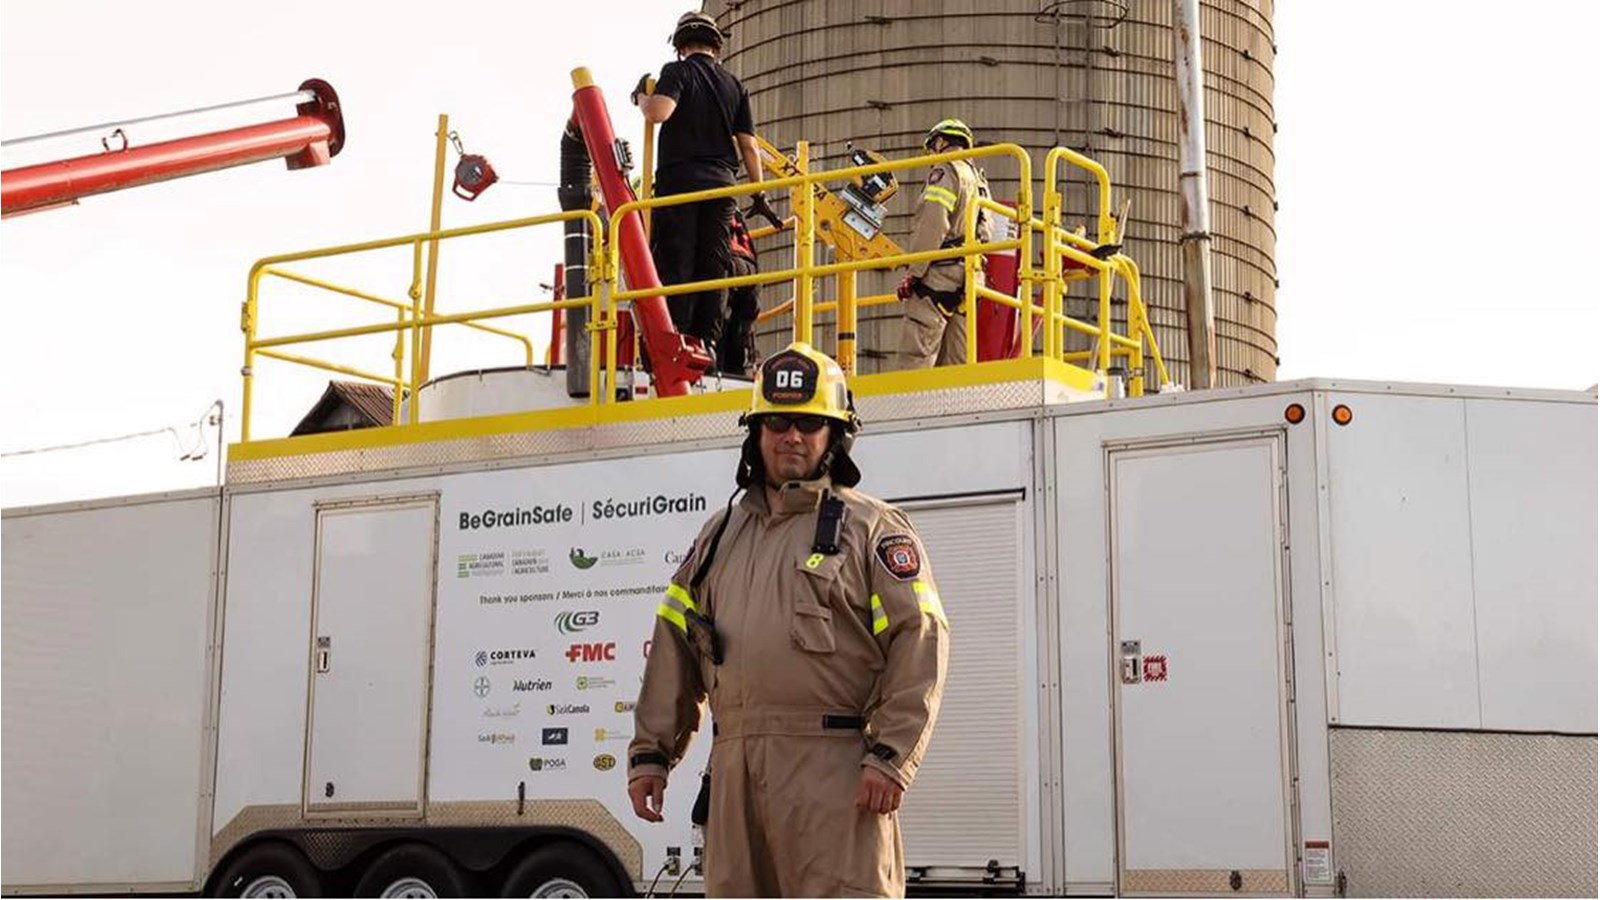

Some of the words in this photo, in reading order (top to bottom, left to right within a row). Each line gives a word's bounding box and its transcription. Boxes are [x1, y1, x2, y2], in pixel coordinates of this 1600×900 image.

[776, 370, 803, 388] 06
[459, 504, 573, 530] BeGrainSafe
[592, 493, 707, 519] SécuriGrain
[806, 553, 824, 568] 8
[479, 595, 502, 604] Thank
[503, 596, 518, 604] you
[520, 592, 554, 603] sponsors
[562, 590, 585, 599] Merci
[594, 590, 609, 598] nos
[610, 585, 669, 596] commanditair
[572, 612, 600, 626] G3
[490, 649, 537, 660] CORTEVA
[565, 642, 616, 662] FMC
[513, 678, 553, 691] Nutrien
